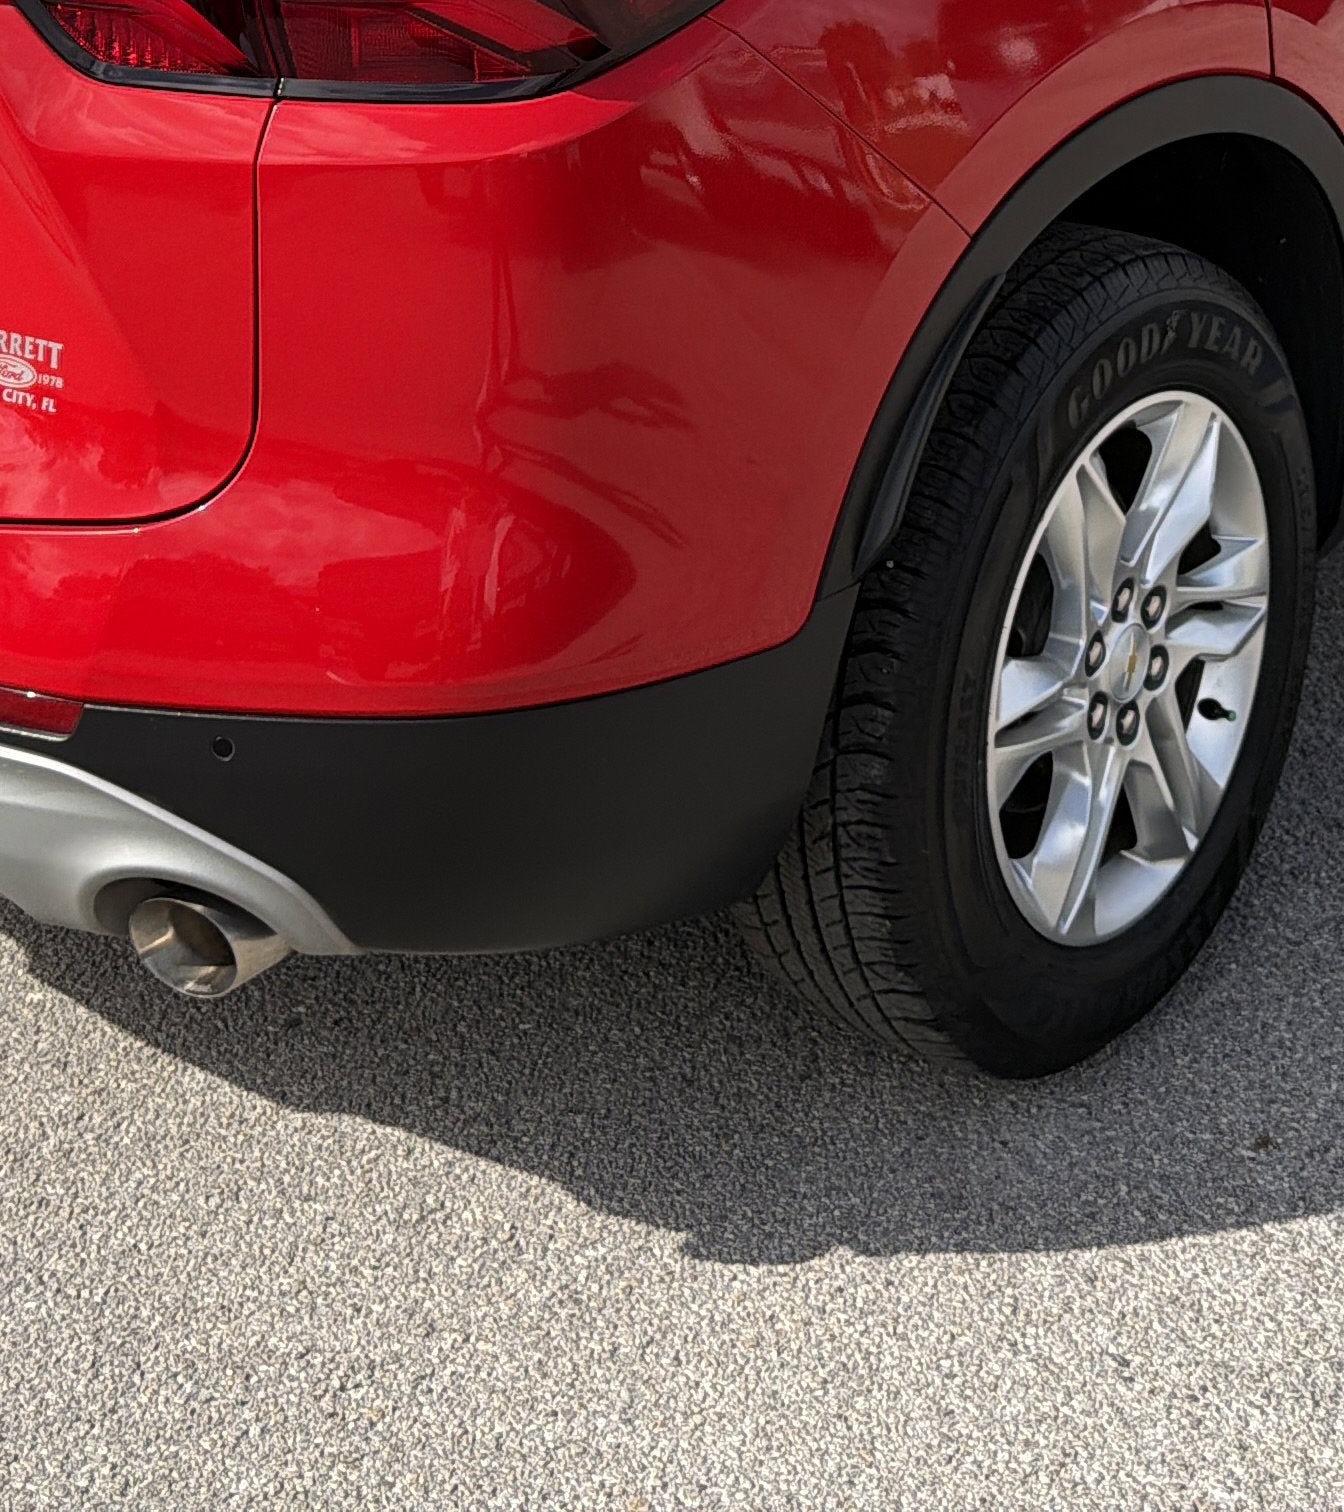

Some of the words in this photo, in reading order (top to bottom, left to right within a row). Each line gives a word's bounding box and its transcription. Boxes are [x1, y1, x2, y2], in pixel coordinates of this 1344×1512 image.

[37, 373, 64, 389] 1978
[2, 388, 37, 410] CITY,
[41, 396, 58, 413] FL
